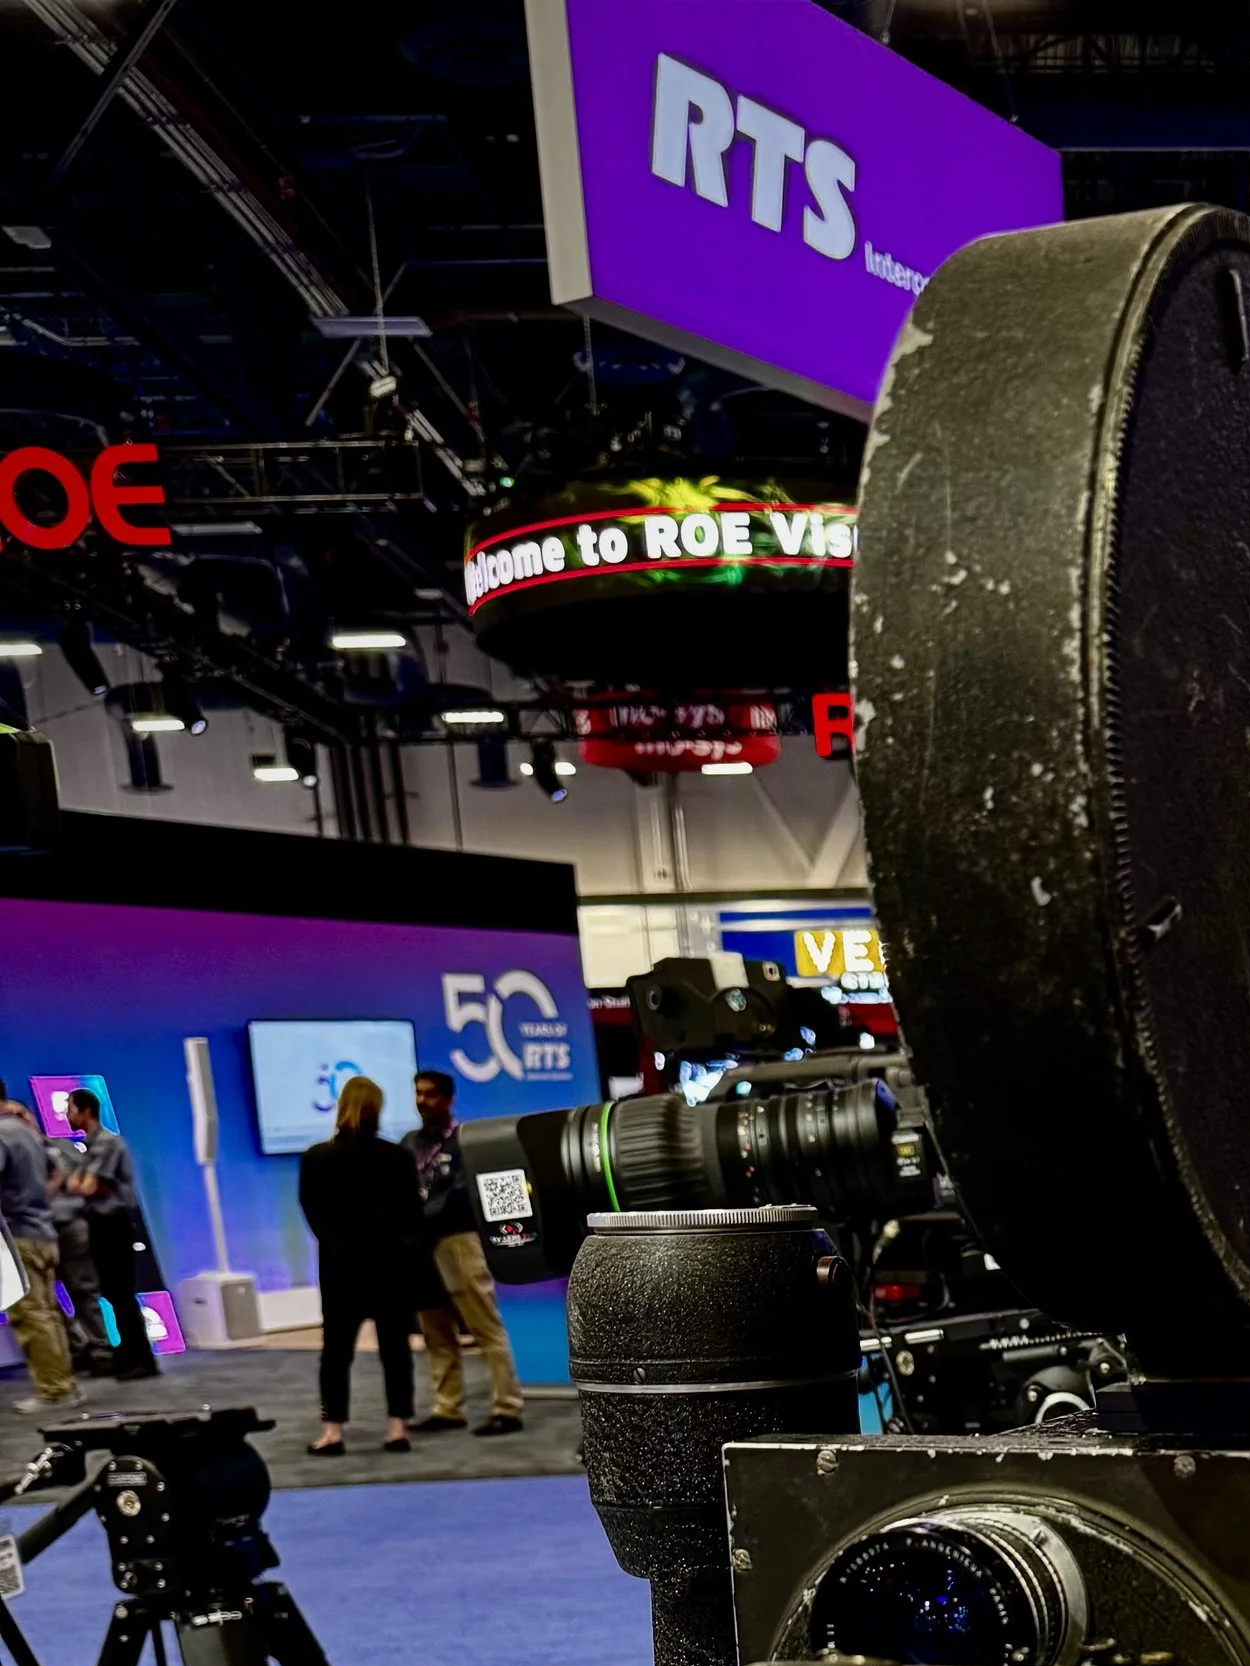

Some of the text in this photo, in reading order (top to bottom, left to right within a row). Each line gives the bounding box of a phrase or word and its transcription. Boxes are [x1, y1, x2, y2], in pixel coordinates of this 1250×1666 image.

[651, 52, 857, 260] RTS
[0, 443, 173, 550] OE
[576, 523, 629, 566] to
[643, 512, 754, 559] ROE
[769, 512, 859, 558] Vis
[803, 930, 886, 974] VE
[441, 969, 559, 1082] 50
[523, 1041, 570, 1070] RTS
